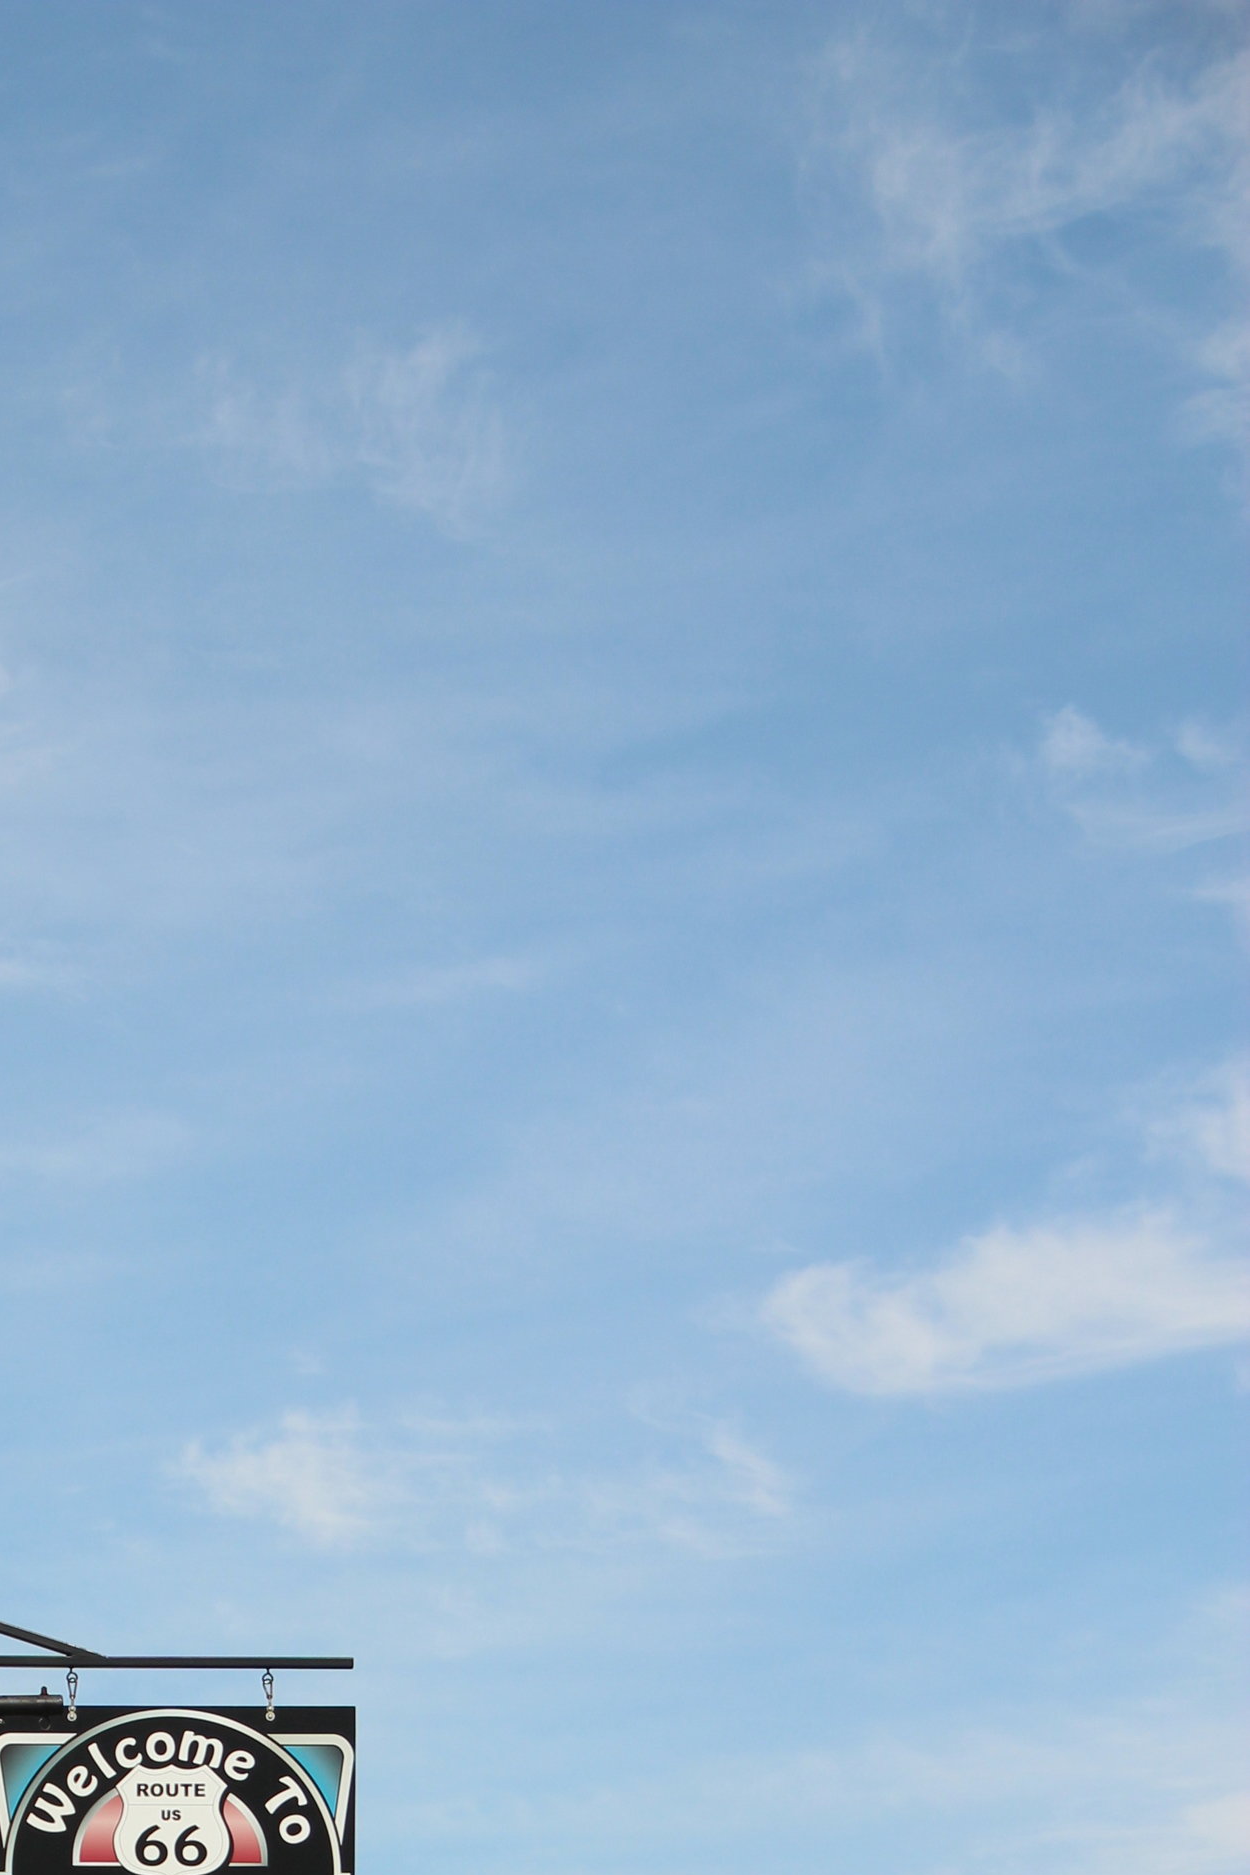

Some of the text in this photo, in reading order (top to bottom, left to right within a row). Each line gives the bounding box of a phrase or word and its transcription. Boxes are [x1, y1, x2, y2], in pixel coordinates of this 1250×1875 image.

[26, 1730, 311, 1845] Welcome To
[136, 1783, 206, 1798] ROUTE
[161, 1809, 182, 1822] US
[135, 1824, 208, 1867] 66
